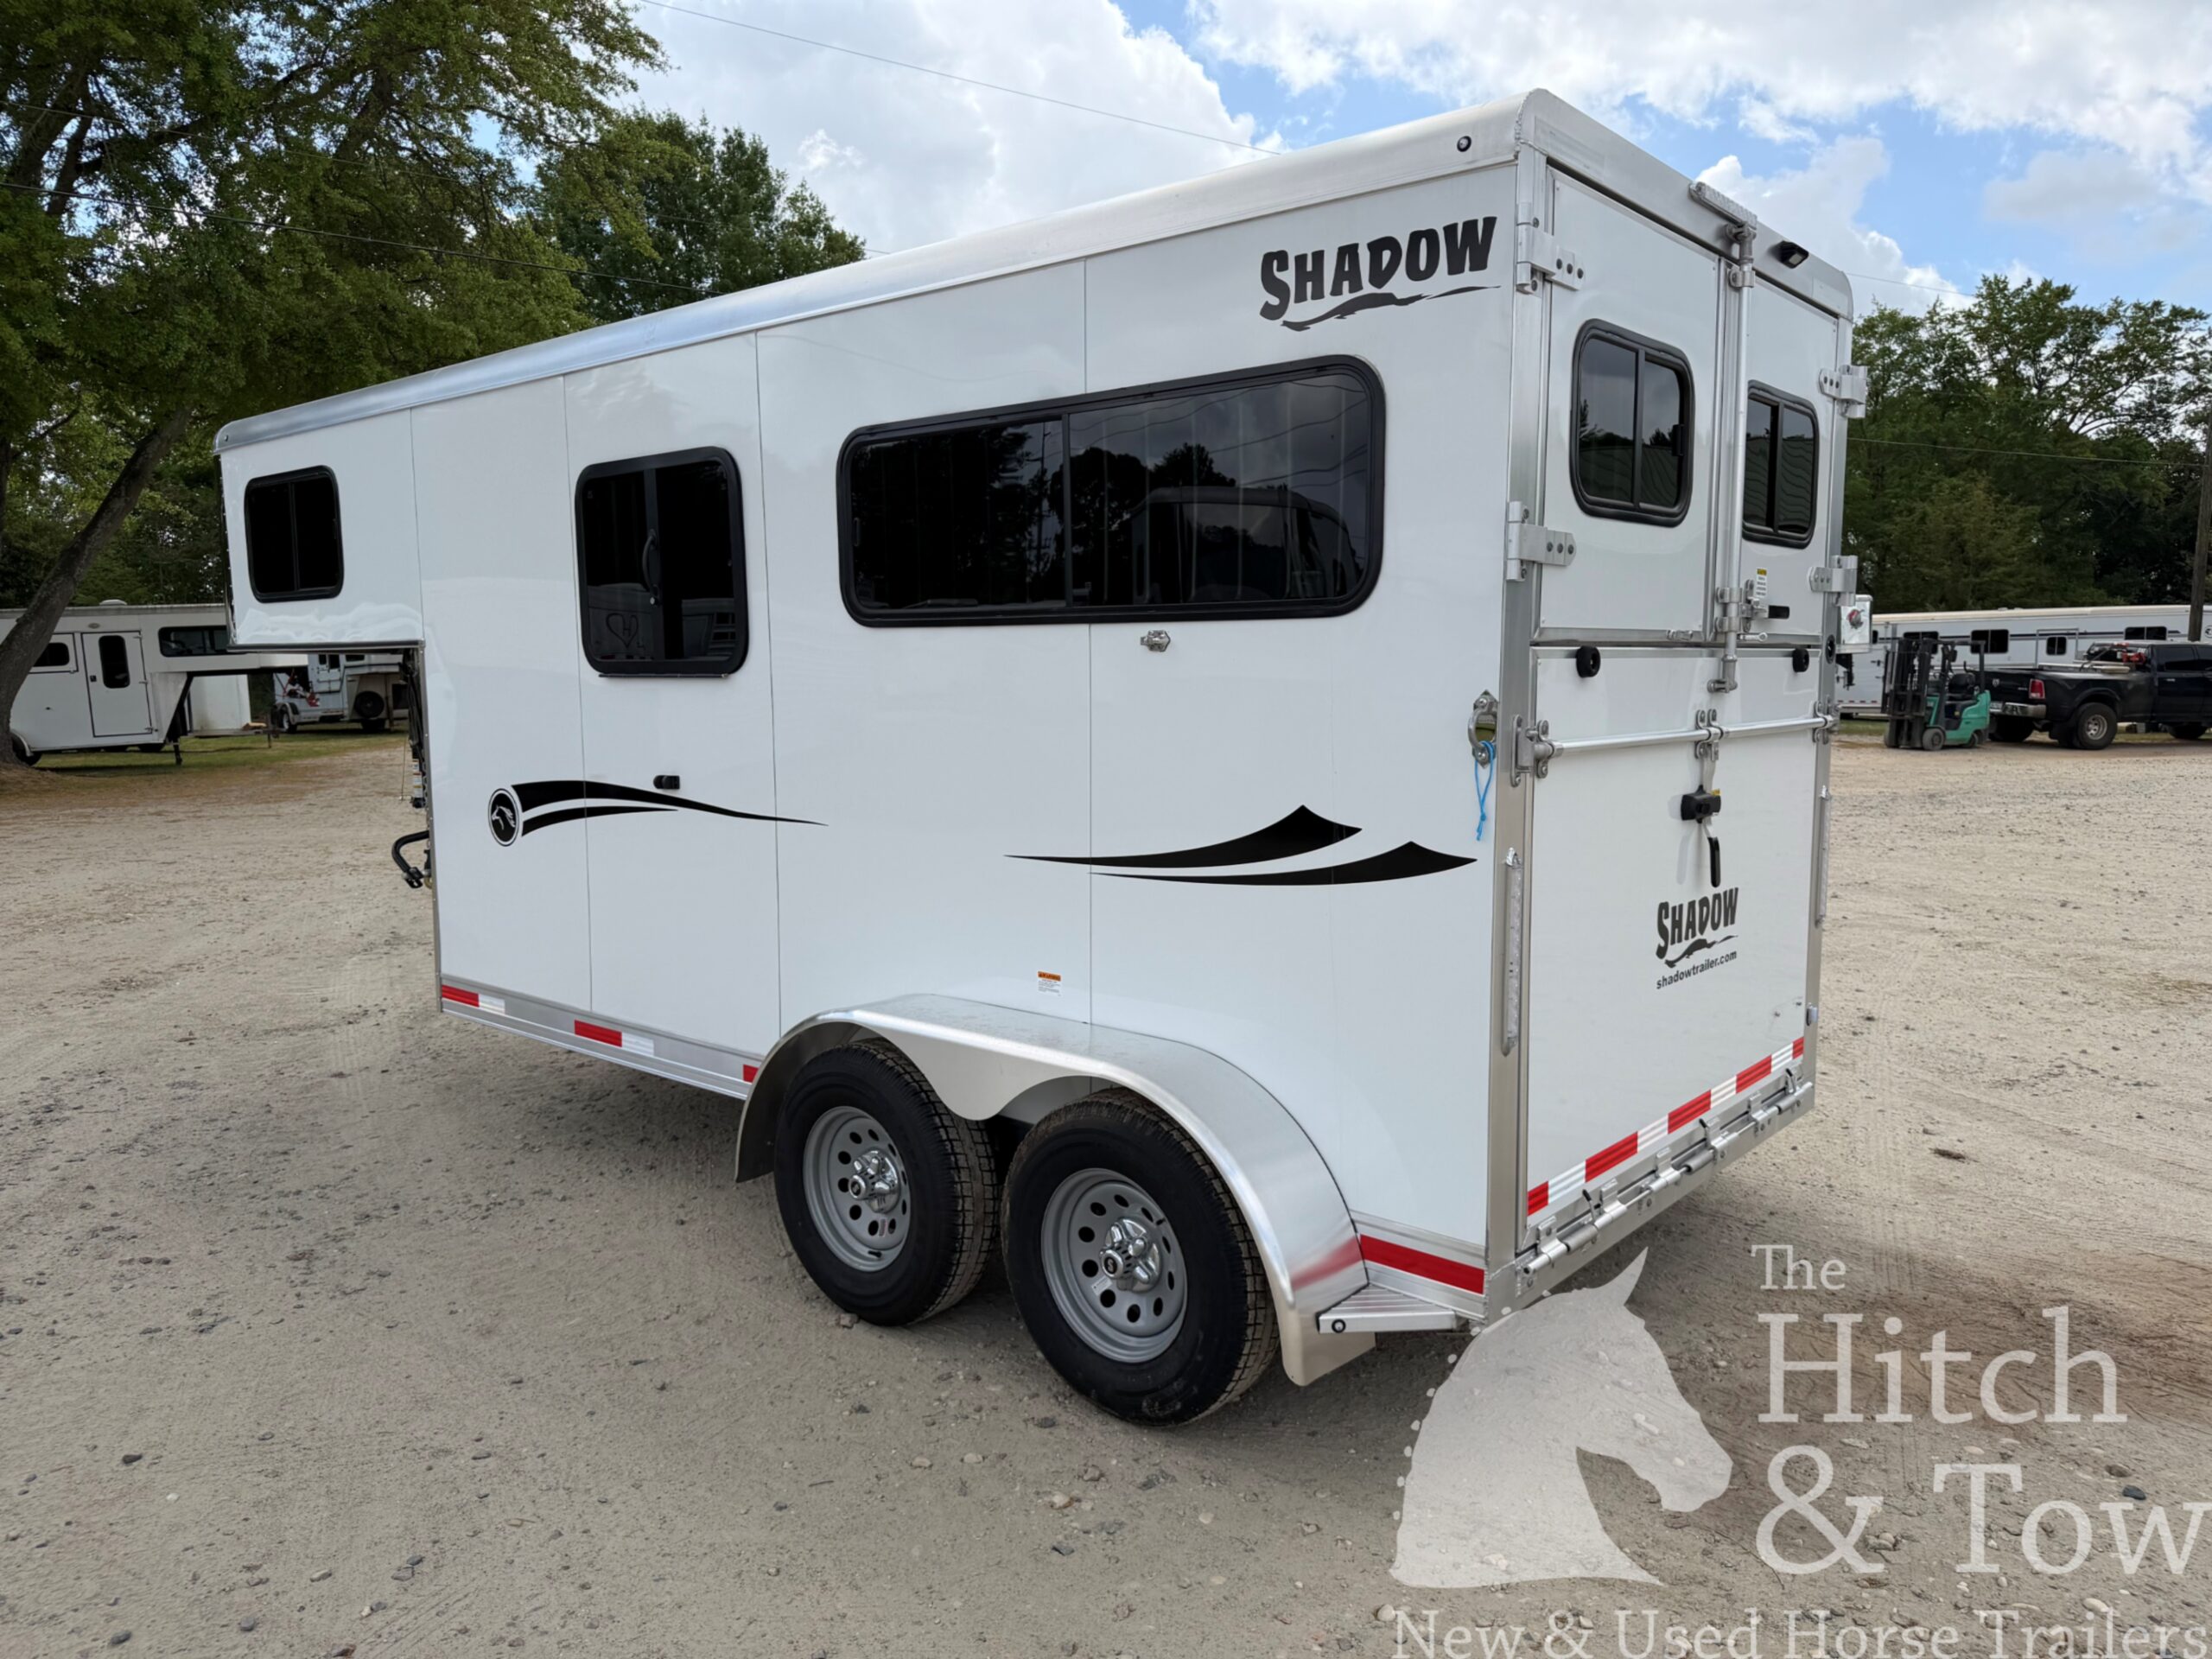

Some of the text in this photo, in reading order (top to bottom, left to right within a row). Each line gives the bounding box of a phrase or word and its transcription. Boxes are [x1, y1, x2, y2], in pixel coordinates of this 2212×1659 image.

[1260, 216, 1497, 321] SHADOW
[1656, 887, 1738, 959] SHADOW
[1656, 950, 1737, 989] shadowtrailer.com
